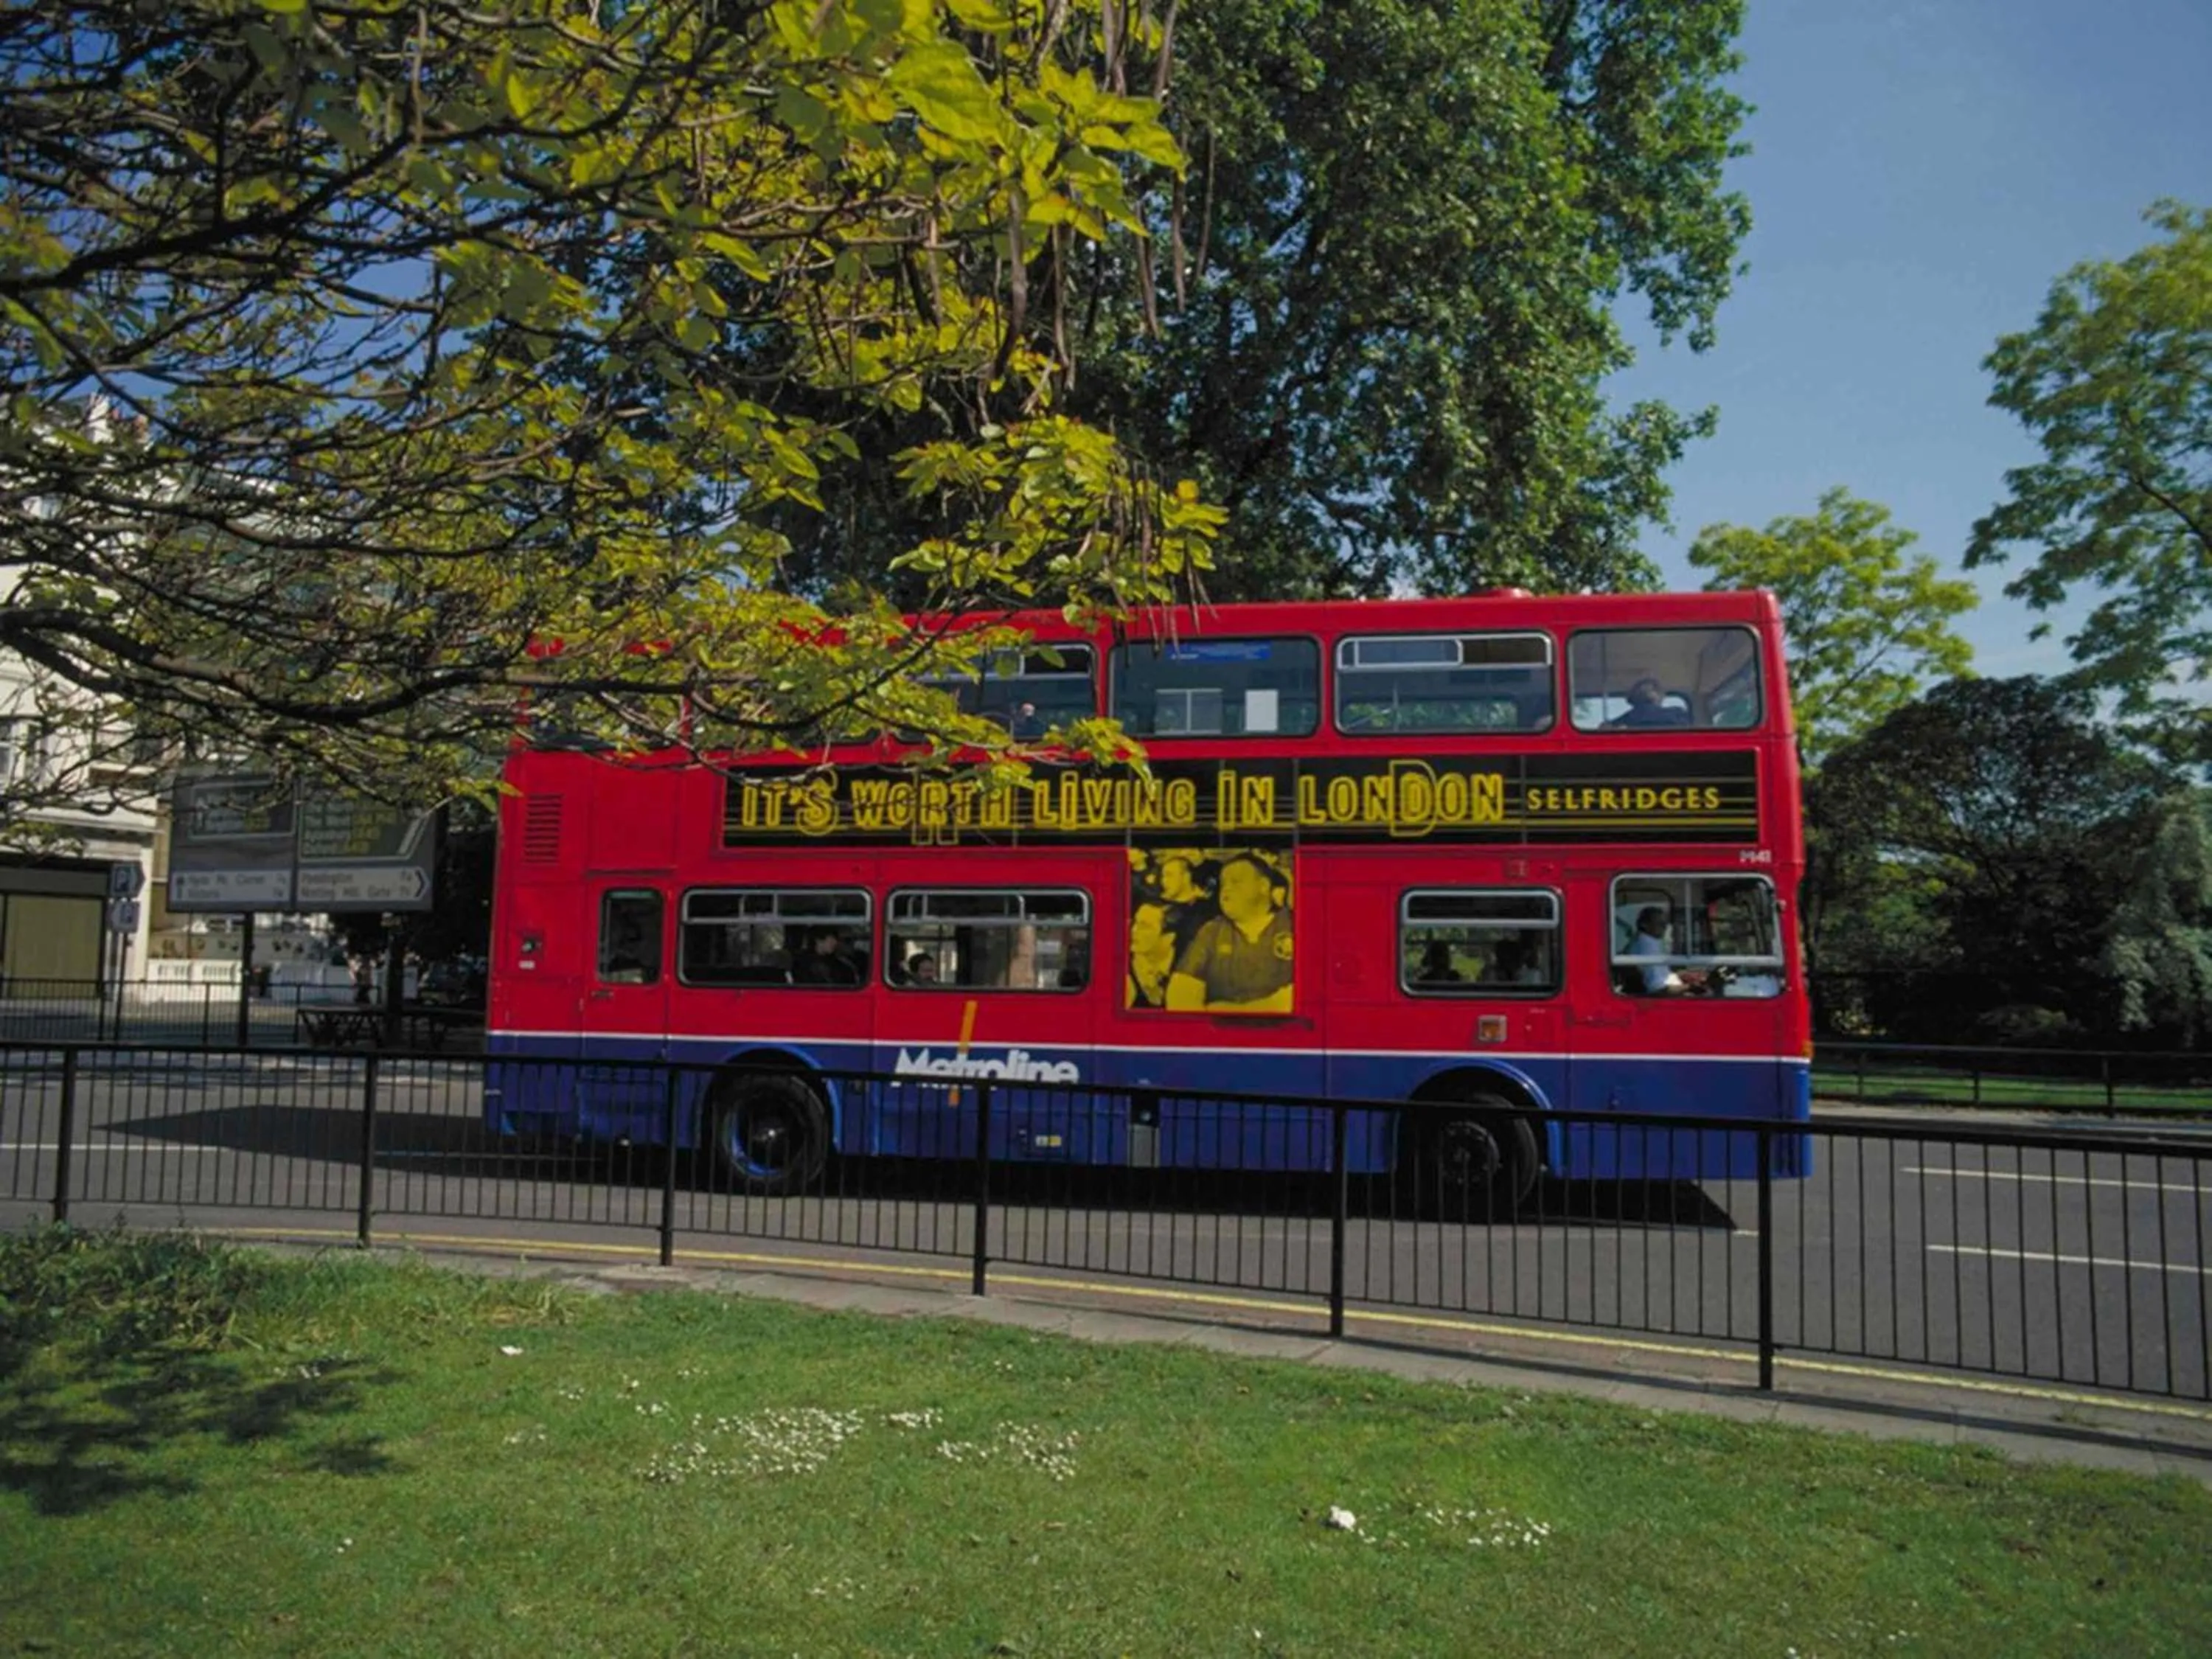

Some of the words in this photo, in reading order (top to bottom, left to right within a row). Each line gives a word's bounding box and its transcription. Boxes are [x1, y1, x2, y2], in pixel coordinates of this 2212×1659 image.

[741, 771, 838, 836] IT'S
[851, 774, 1012, 845] WORTH
[1033, 771, 1196, 830] LIVING
[1217, 770, 1275, 830] IN
[1298, 761, 1505, 837] LONDON
[1527, 787, 1720, 811] SELFRIDGES
[890, 1046, 1080, 1091] Metroline
